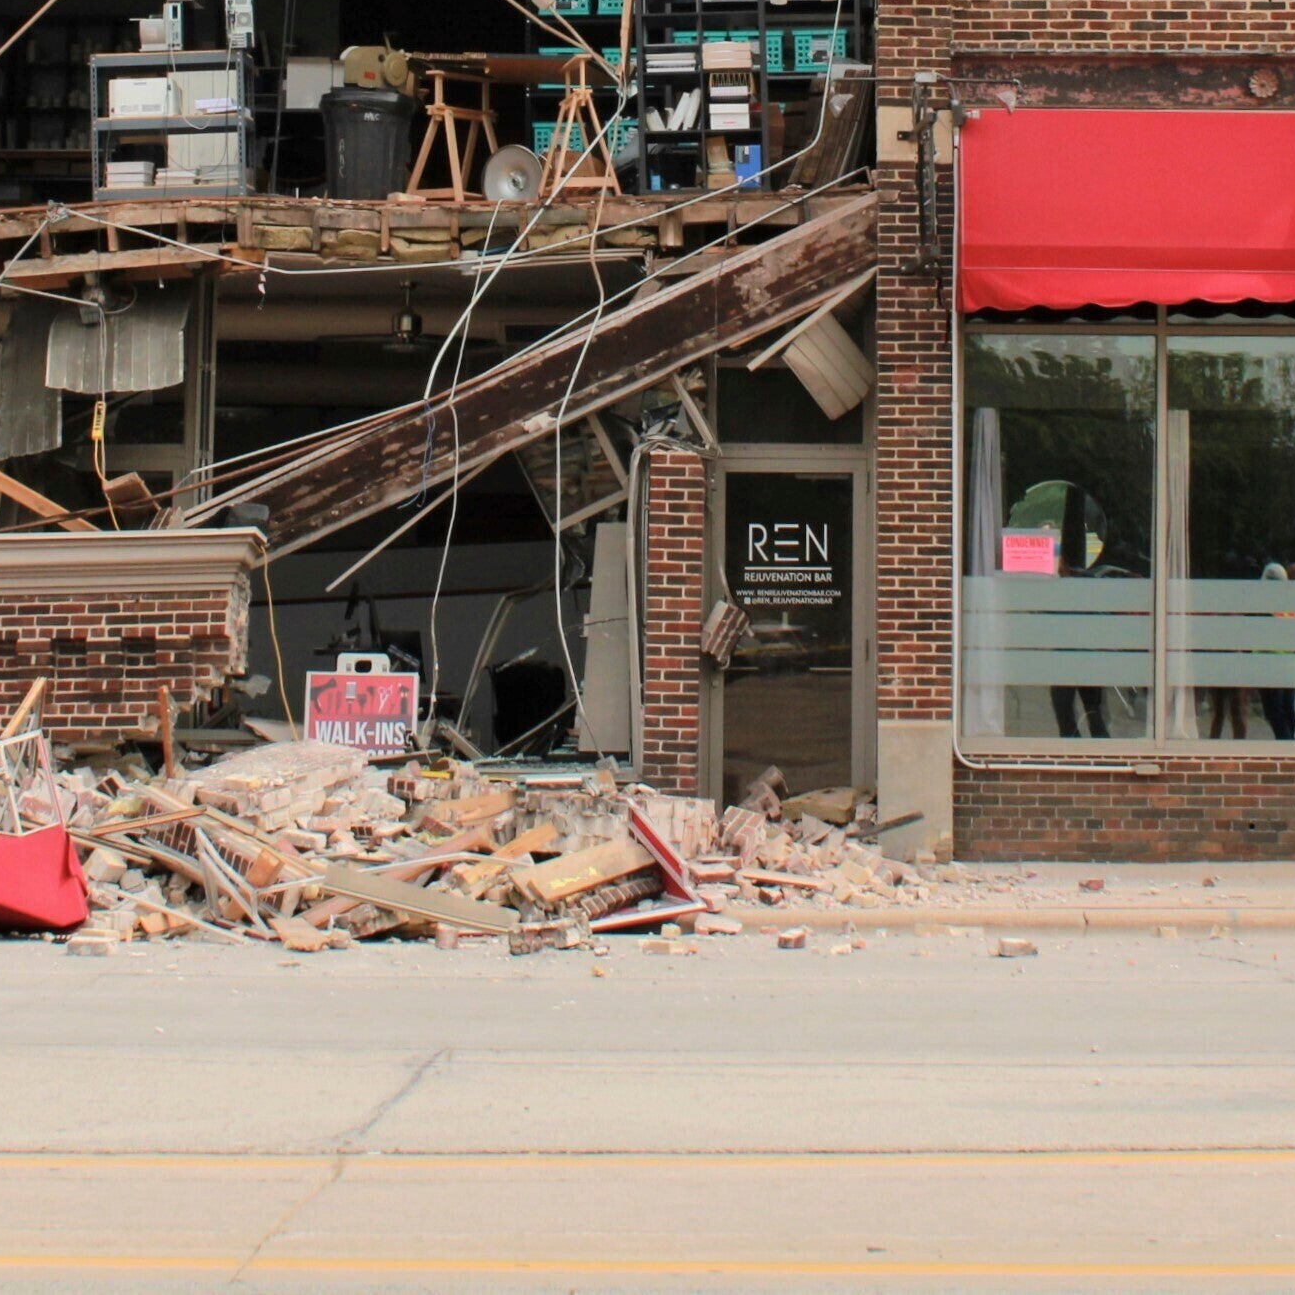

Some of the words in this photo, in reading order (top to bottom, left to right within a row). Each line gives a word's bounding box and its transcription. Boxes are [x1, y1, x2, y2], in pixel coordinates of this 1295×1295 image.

[748, 523, 828, 562] REN
[744, 572, 811, 582] REJUVENATION
[814, 572, 832, 582] BAR
[315, 720, 407, 746] WALK-INS
